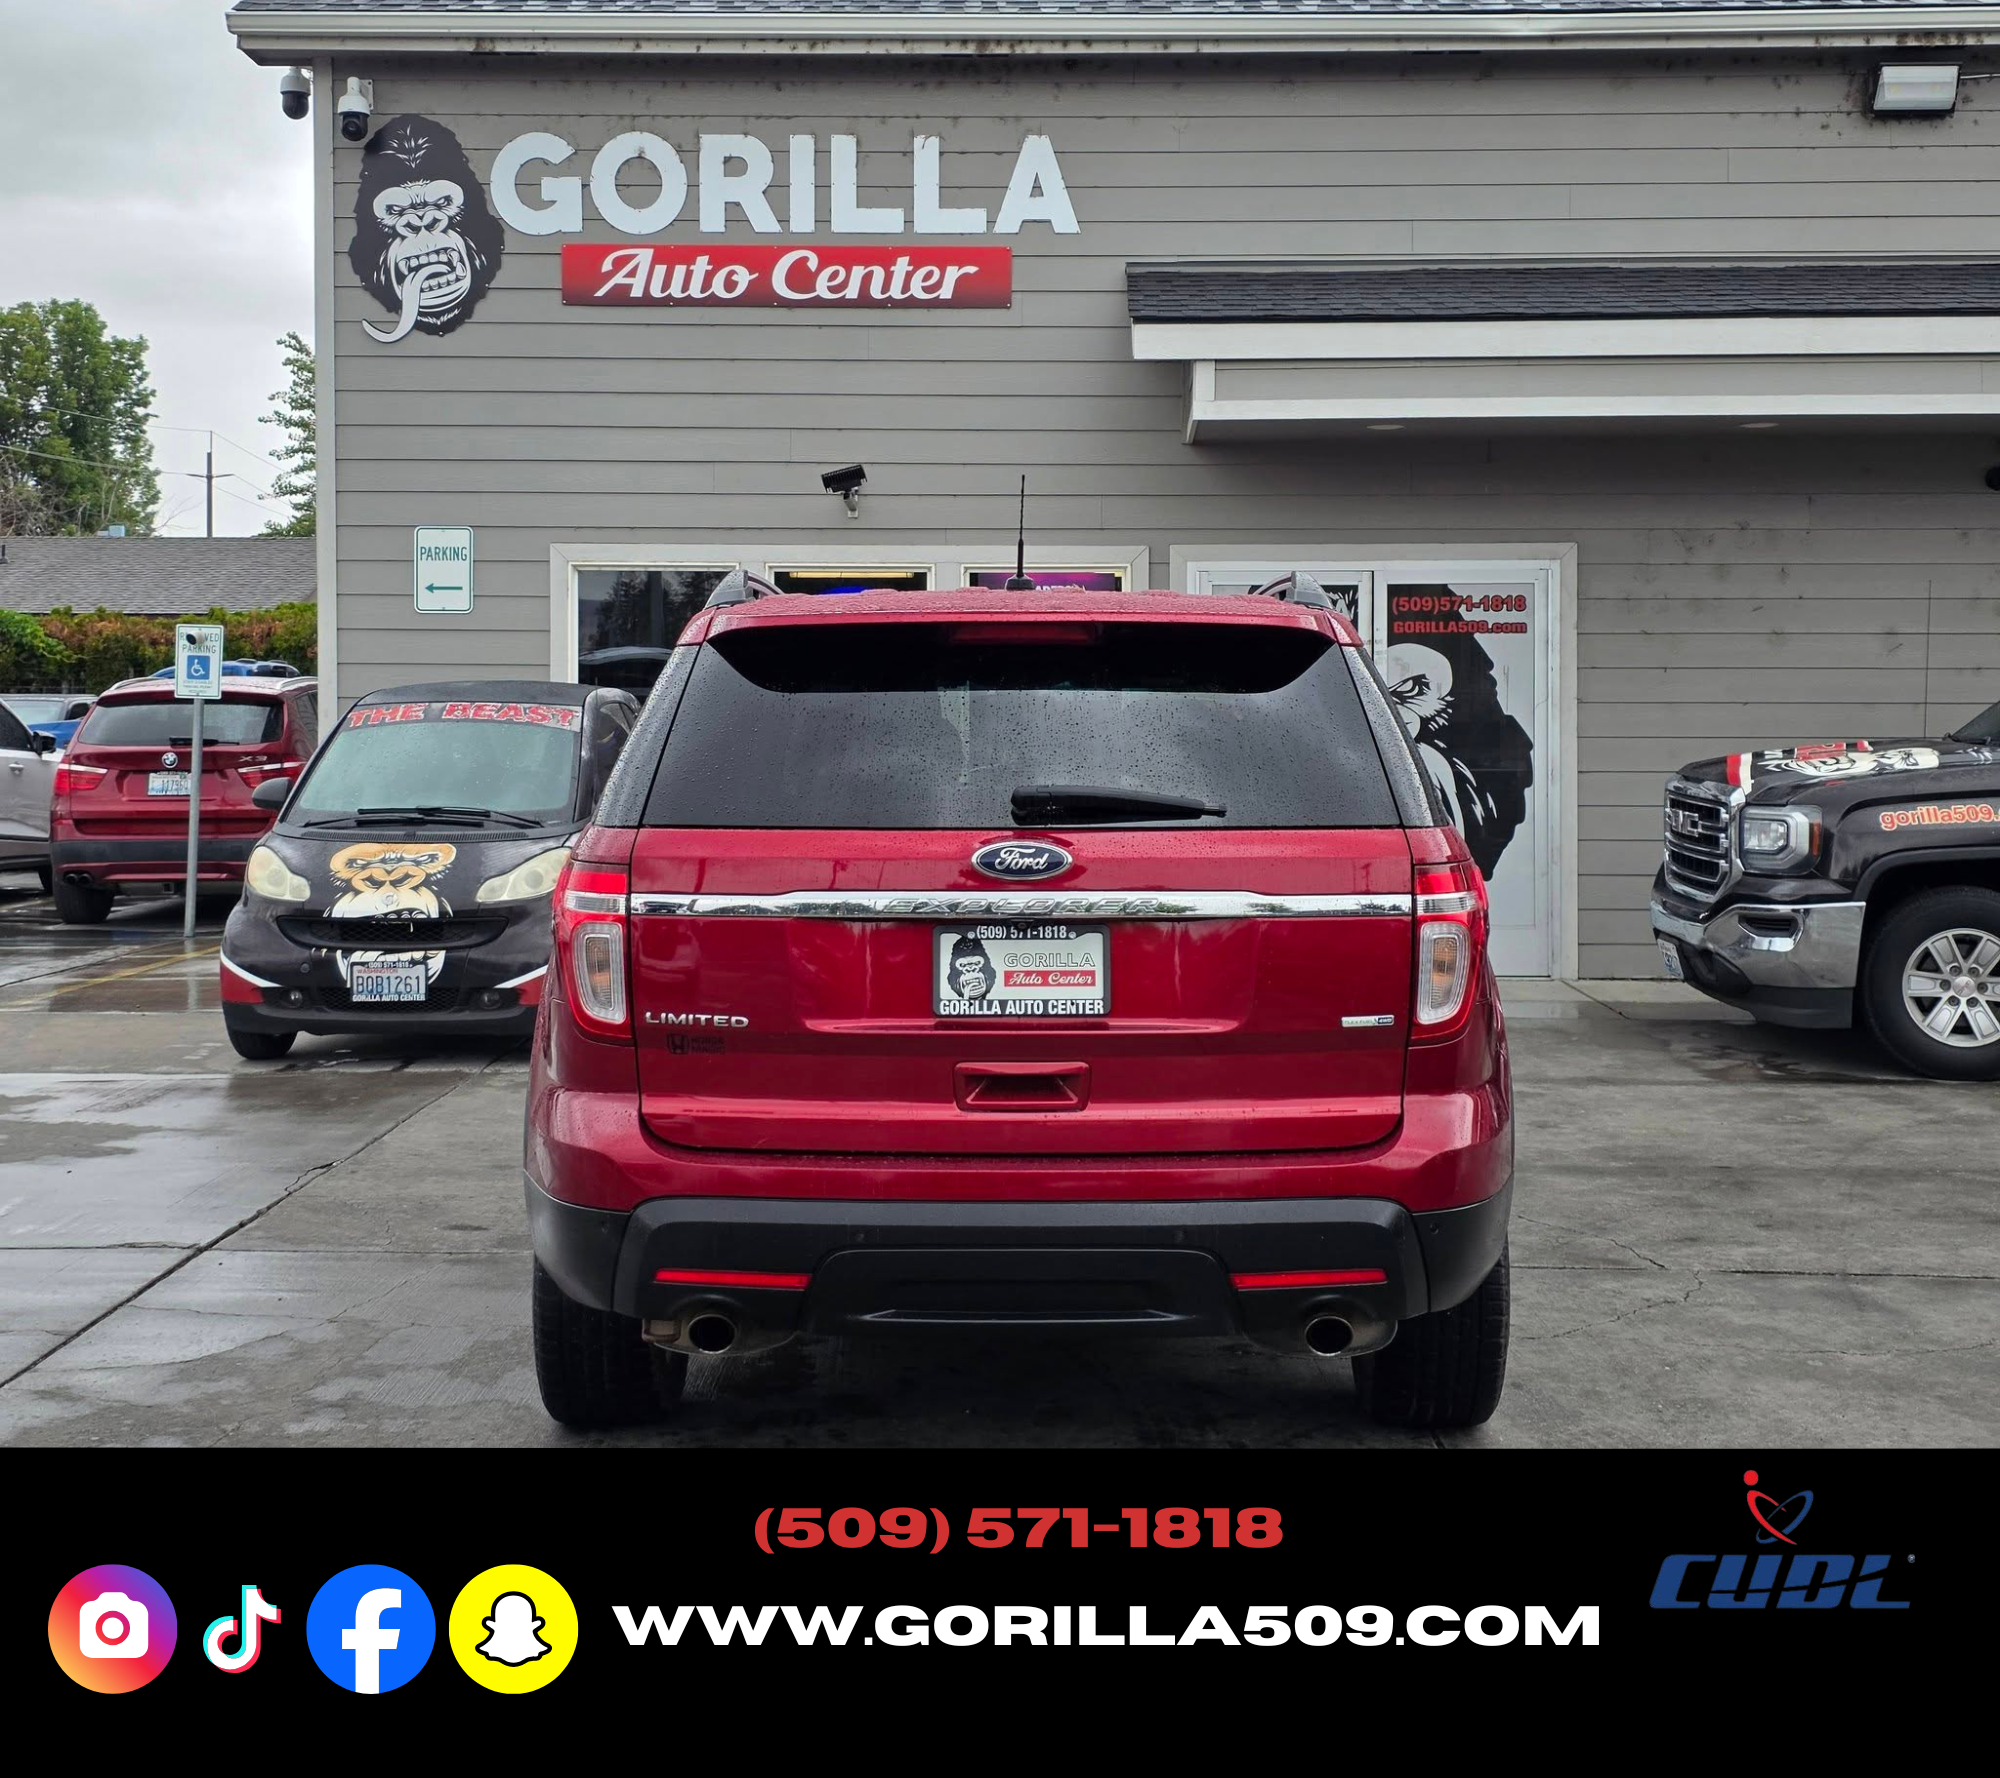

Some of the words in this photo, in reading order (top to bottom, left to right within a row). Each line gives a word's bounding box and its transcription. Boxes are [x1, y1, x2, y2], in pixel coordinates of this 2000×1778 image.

[490, 132, 1081, 236] GORILLA
[594, 248, 758, 299] Auto
[772, 249, 978, 301] Center
[420, 546, 468, 562] PARKING
[1392, 595, 1527, 615] (509)571-1818
[1393, 620, 1527, 633] GORILLA509.com
[180, 632, 220, 642] RVED
[182, 644, 217, 654] PARKING
[348, 703, 429, 728] THE
[441, 702, 580, 727] BEAST
[1879, 804, 2000, 831] gorilla509.
[995, 847, 1050, 871] Ford
[883, 898, 1160, 914] EXPLORER
[976, 926, 1007, 940] (509)
[1003, 952, 1096, 968] GORILLA
[356, 975, 420, 994] BQB1261
[1009, 972, 1043, 985] Auto
[1048, 972, 1093, 985] Center
[939, 1000, 1001, 1015] GORILLA
[1005, 1000, 1044, 1015] AUTO
[1048, 1000, 1104, 1015] CENTER
[645, 1011, 749, 1028] LIMITED
